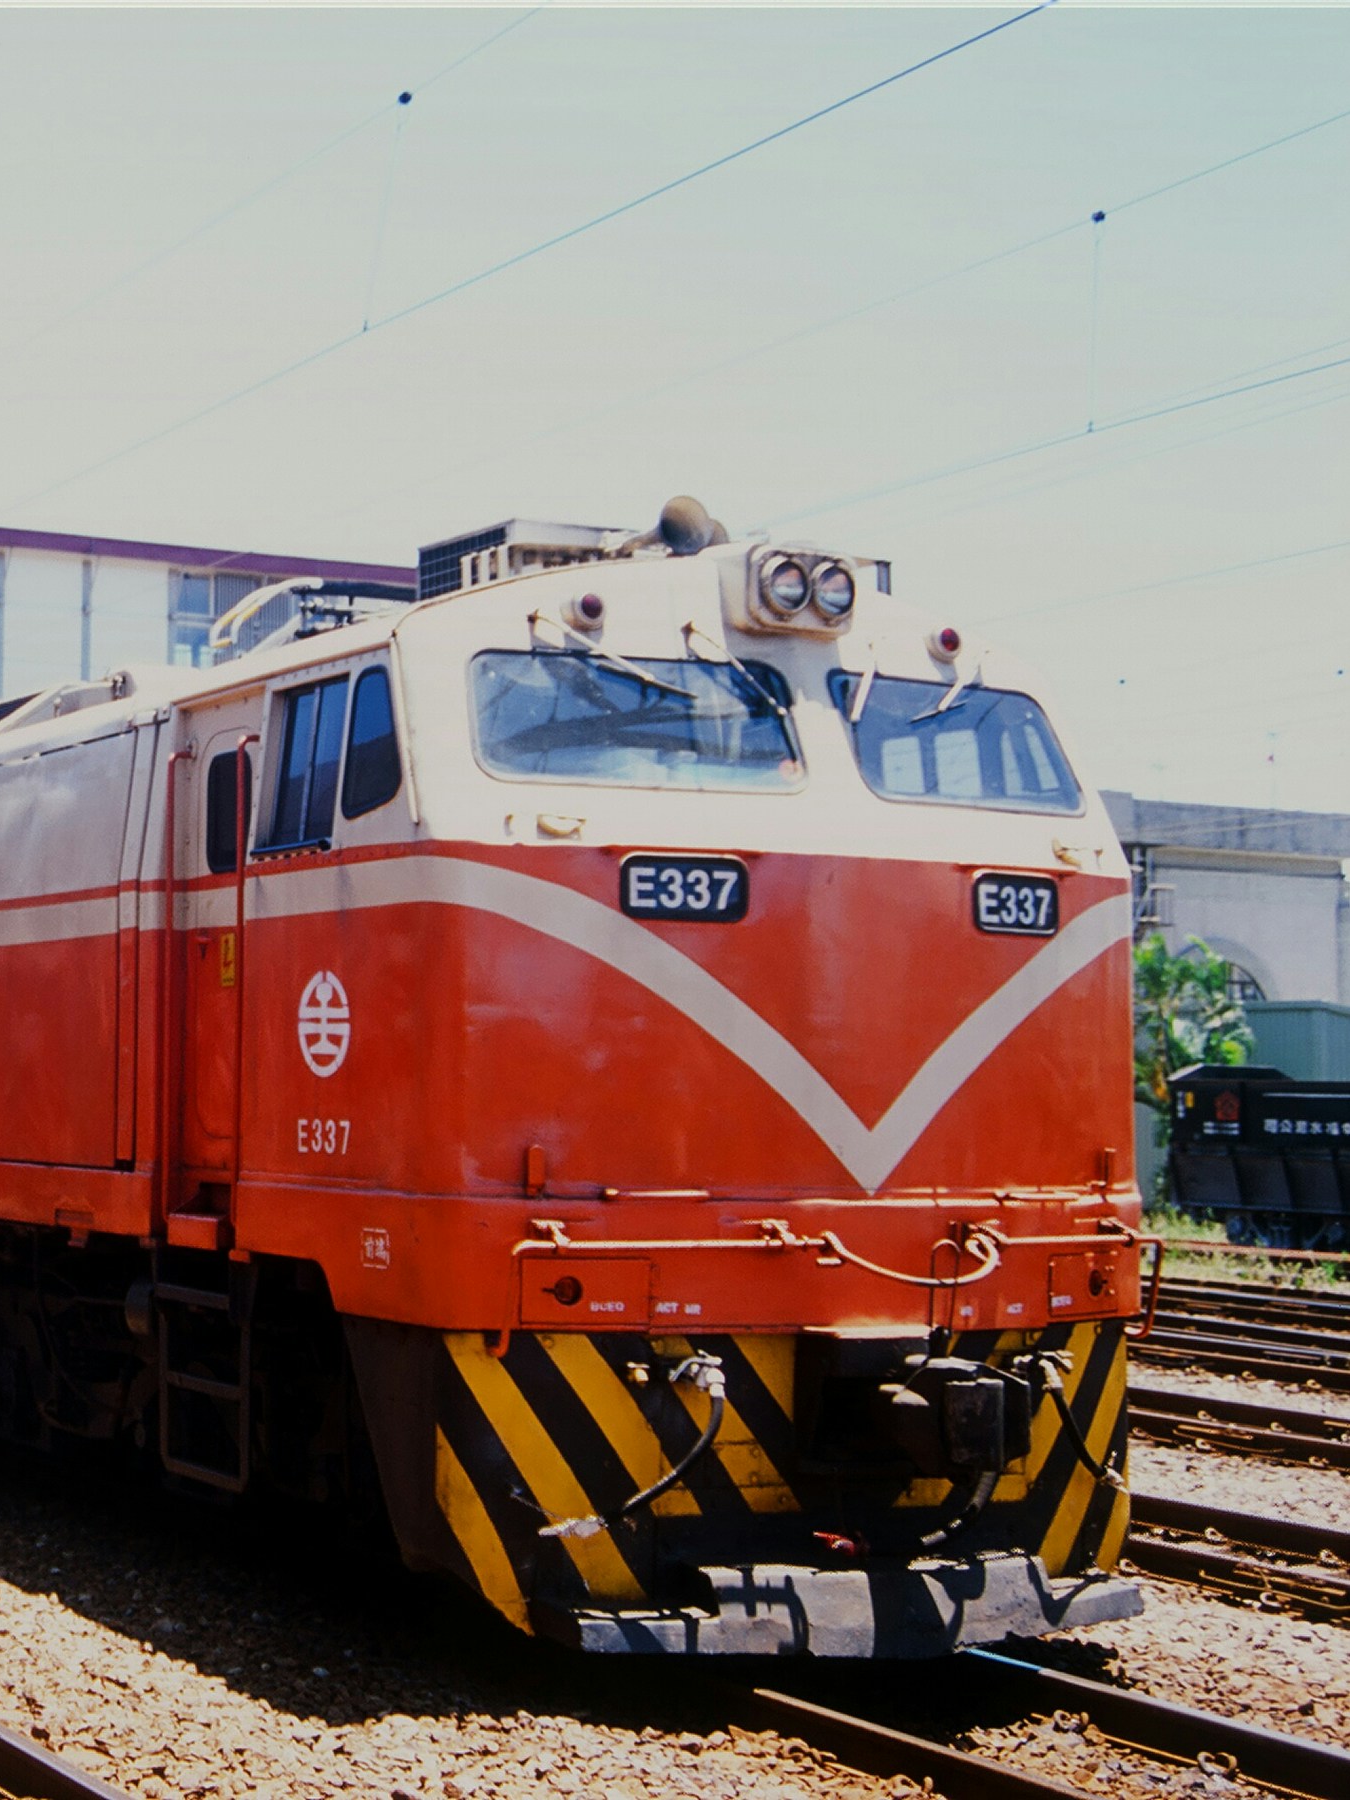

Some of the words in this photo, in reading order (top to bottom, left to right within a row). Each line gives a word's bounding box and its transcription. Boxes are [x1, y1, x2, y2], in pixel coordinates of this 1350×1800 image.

[629, 867, 738, 910] E337
[978, 884, 1052, 926] E337
[297, 1118, 351, 1155] E337
